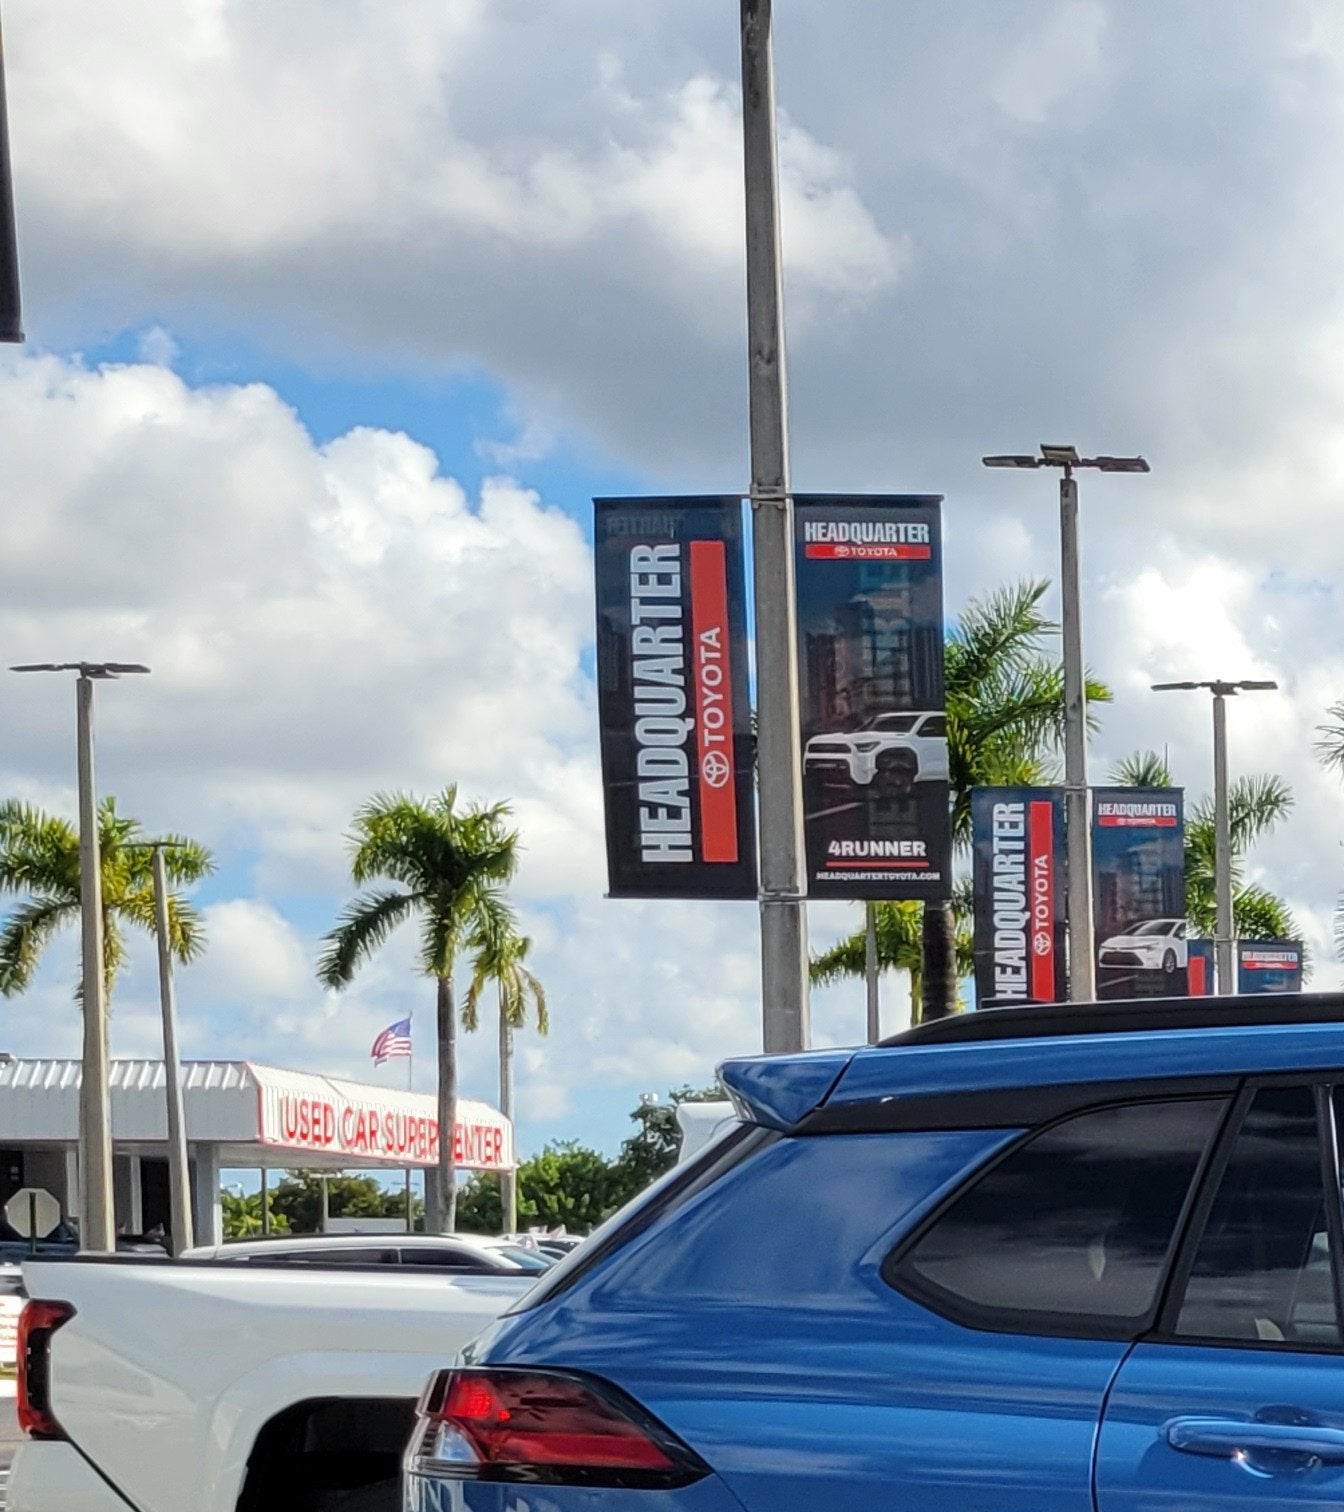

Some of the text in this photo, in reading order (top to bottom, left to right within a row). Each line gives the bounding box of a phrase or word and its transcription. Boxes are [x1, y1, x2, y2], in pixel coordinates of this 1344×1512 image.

[804, 522, 929, 544] HEADQUARTER
[852, 547, 897, 556] TOYOTA
[630, 543, 695, 863] HEADQUARTER
[699, 627, 725, 747] TOYOTA
[1098, 803, 1177, 817] HEADQUARTER
[828, 840, 927, 857] 4RUNNER
[992, 802, 1030, 998] HEADQUARTER
[1034, 854, 1049, 930] TOYOTA
[283, 1097, 503, 1163] USED CAR SUPERENTER
